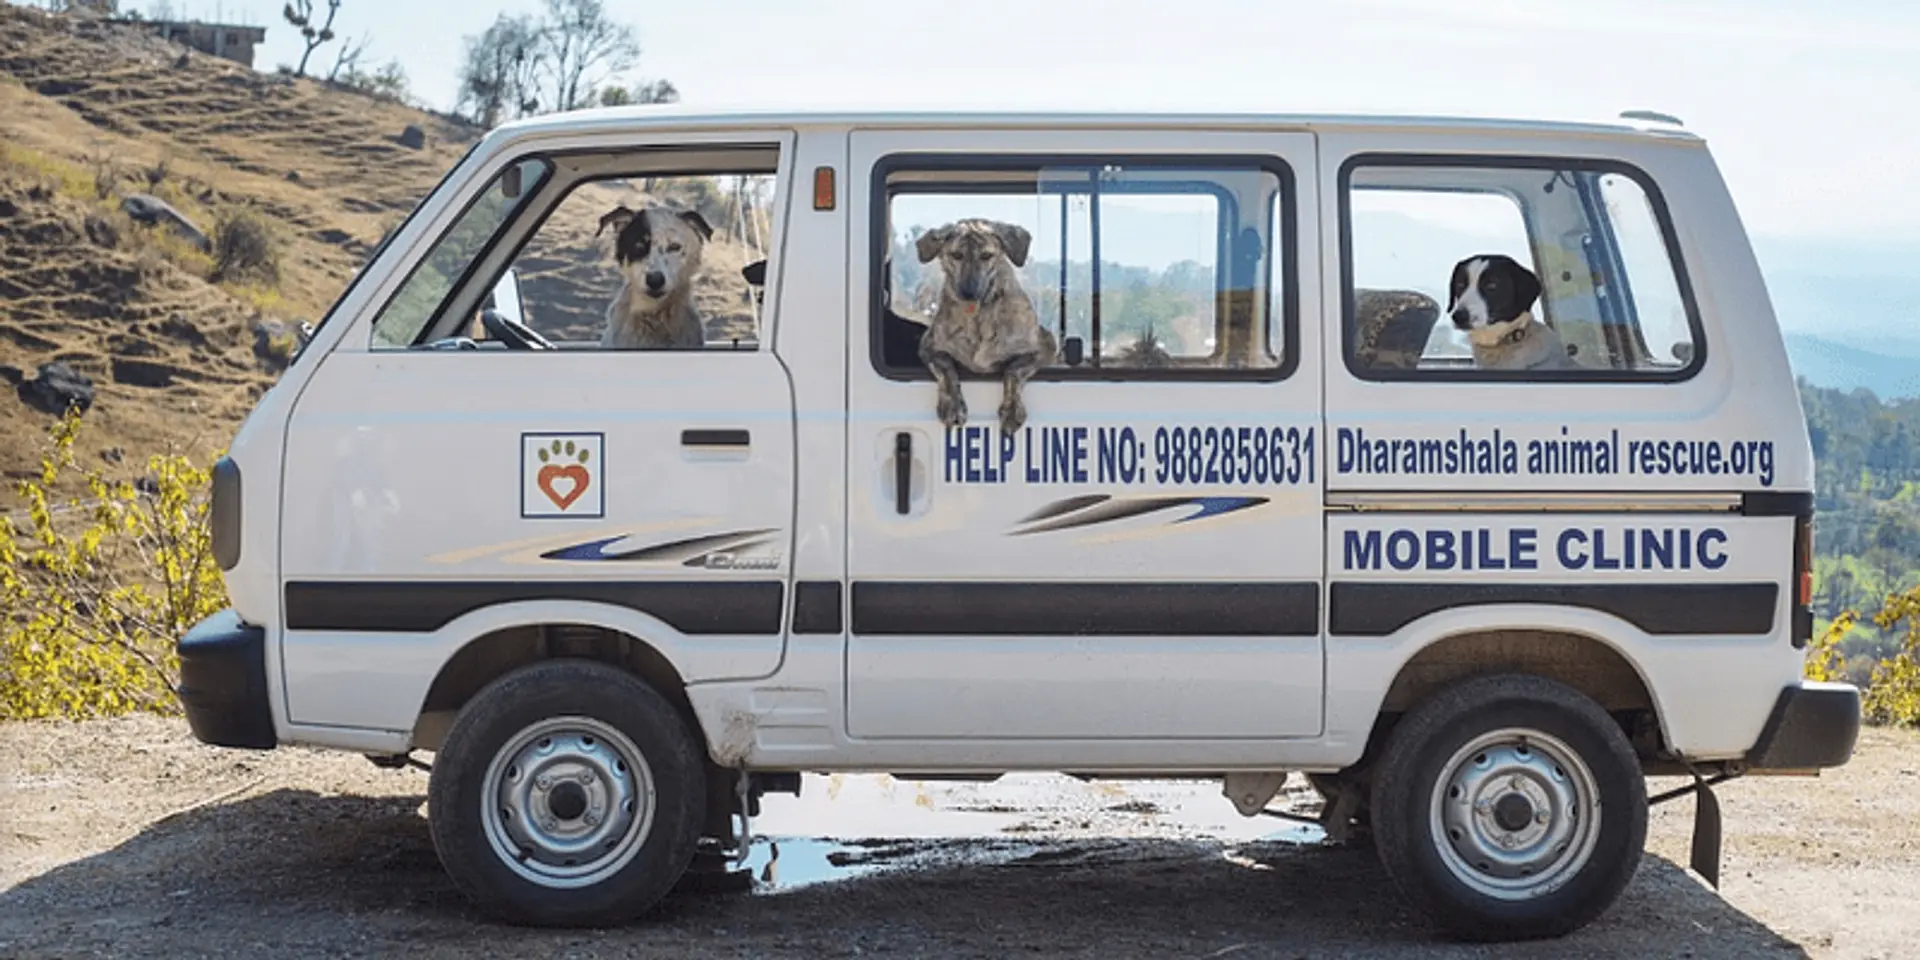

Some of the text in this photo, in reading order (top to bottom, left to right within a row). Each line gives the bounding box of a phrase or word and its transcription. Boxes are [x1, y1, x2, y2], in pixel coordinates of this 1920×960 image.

[944, 426, 1315, 484] HELP LINE NO: 9882858631
[1337, 426, 1775, 486] Dharamshala animal rescue.org
[1343, 528, 1728, 570] MOBILE CLINIC
